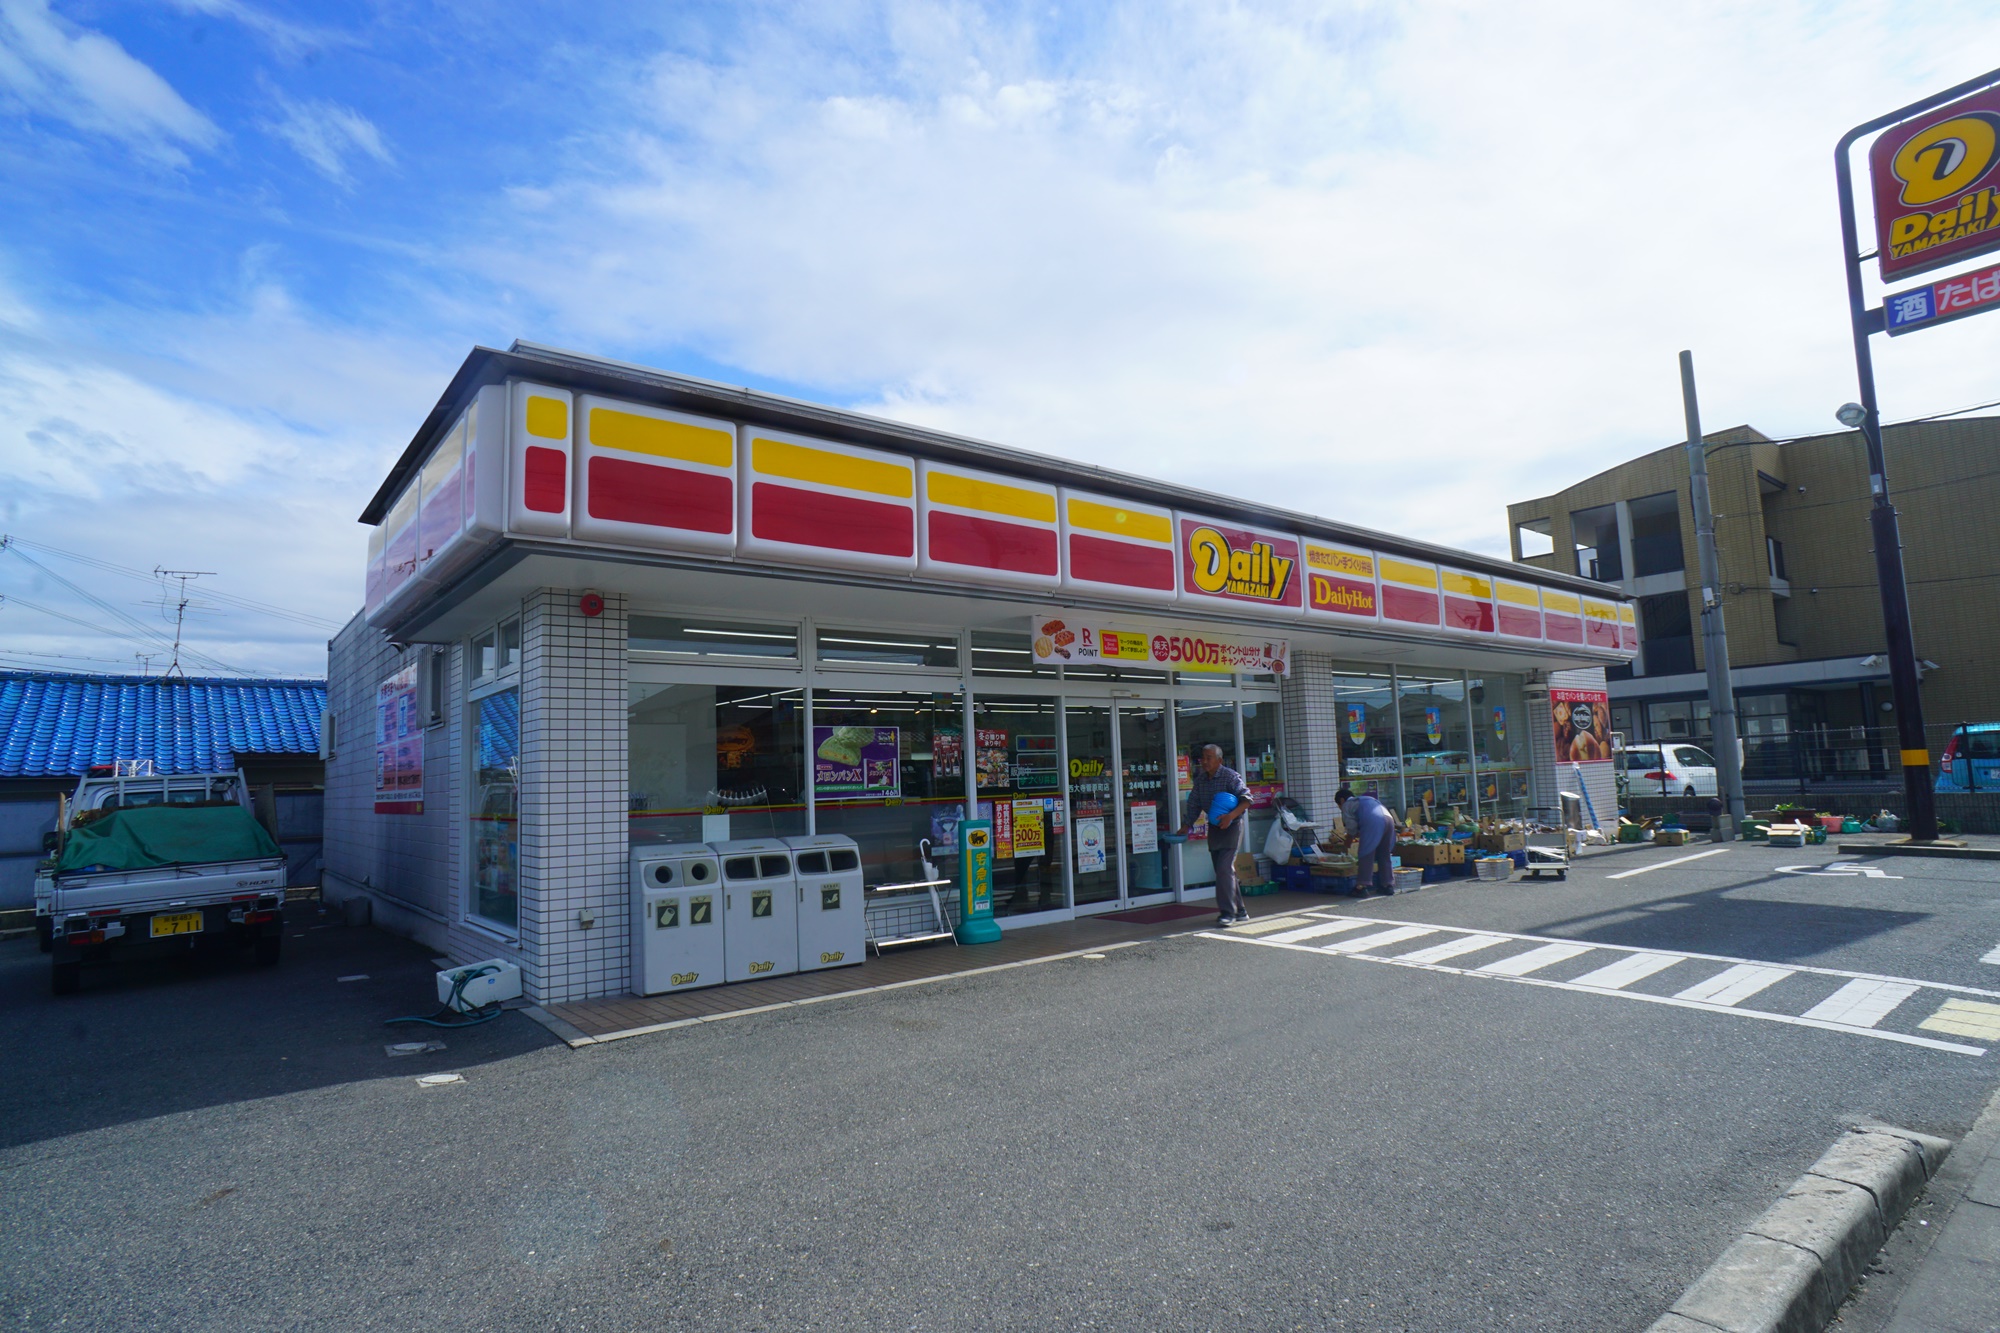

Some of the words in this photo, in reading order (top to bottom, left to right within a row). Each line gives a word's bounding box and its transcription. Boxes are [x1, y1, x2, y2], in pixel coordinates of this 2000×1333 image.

[1892, 219, 1987, 259] YAMAZAKI
[1894, 291, 1928, 325] 酒
[1189, 527, 1296, 600] Daily
[1226, 580, 1270, 599] YAMAZAKI
[1079, 647, 1098, 658] POINT
[1169, 636, 1219, 665] 500万
[1220, 644, 1261, 657] ポイント山分け
[816, 768, 863, 783] メロンパンX
[1069, 758, 1105, 778] Daily
[1015, 828, 1041, 843] 500万
[249, 878, 276, 887] HIJET
[975, 851, 988, 898] 宅急便
[820, 951, 845, 965] Daily
[748, 960, 776, 975] Daily
[671, 971, 700, 987] Daily
